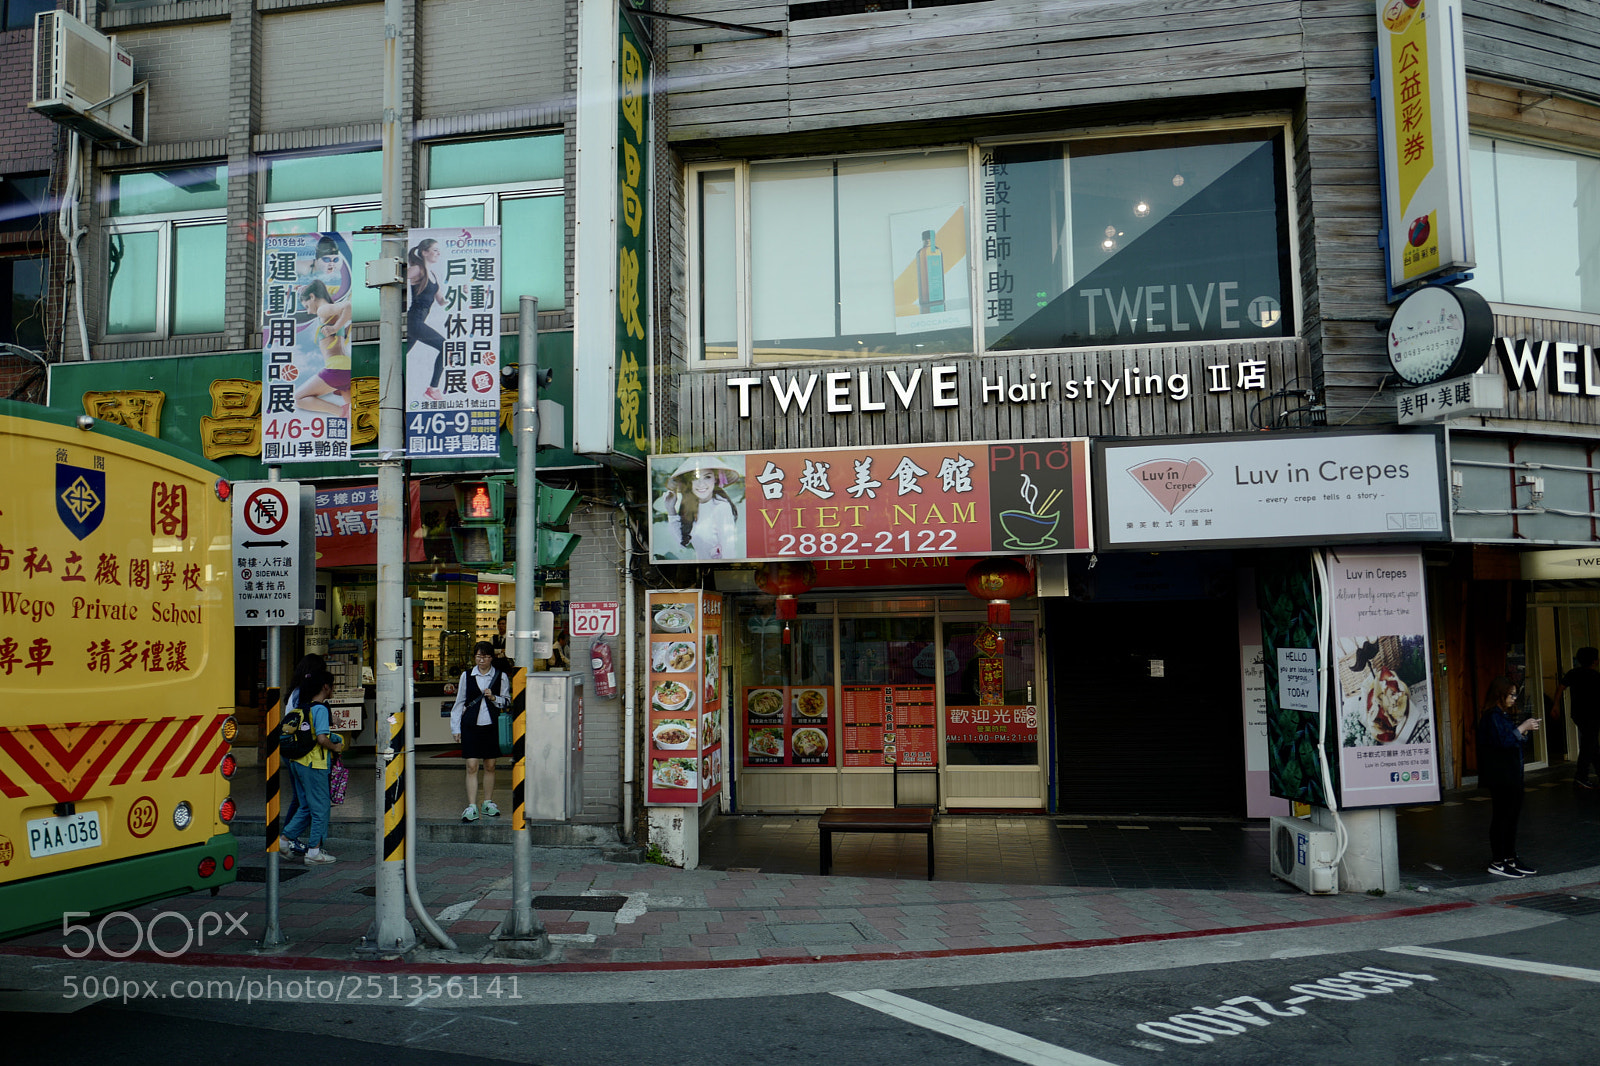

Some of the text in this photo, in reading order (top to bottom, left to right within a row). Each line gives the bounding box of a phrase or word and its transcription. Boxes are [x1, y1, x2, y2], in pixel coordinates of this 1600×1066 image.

[1398, 41, 1425, 165] 公益彩券
[268, 237, 306, 247] 2018台北
[445, 238, 497, 249] SPORTING
[1080, 281, 1240, 336] TWELVE
[727, 365, 959, 419] TWELVE
[982, 372, 1052, 404] Hair
[1065, 366, 1190, 406] styling
[265, 417, 325, 439] 4/6-9
[409, 411, 469, 434] 4/6-9
[755, 452, 976, 500] 台越美食館
[1142, 470, 1164, 482] Luv
[1235, 459, 1409, 485] Luv in Crepes
[1165, 481, 1198, 492] Crepes
[1294, 495, 1316, 503] crepe
[1323, 493, 1340, 501] tells
[759, 501, 978, 530] VIET NAM
[777, 529, 958, 556] 2882-2122
[1346, 568, 1407, 581] Luv in Crepes
[244, 581, 286, 591] 違者拖吊
[274, 592, 292, 600] ZONE
[0, 591, 202, 626] Wego Private School
[265, 609, 285, 618] 110
[577, 615, 611, 631] 207
[87, 638, 190, 674] 請多禮讓
[1285, 651, 1307, 662] HELLO
[1298, 666, 1314, 675] looking
[1287, 688, 1310, 698] TODAY
[950, 708, 1028, 724] 歡迎光臨
[133, 805, 153, 829] 32
